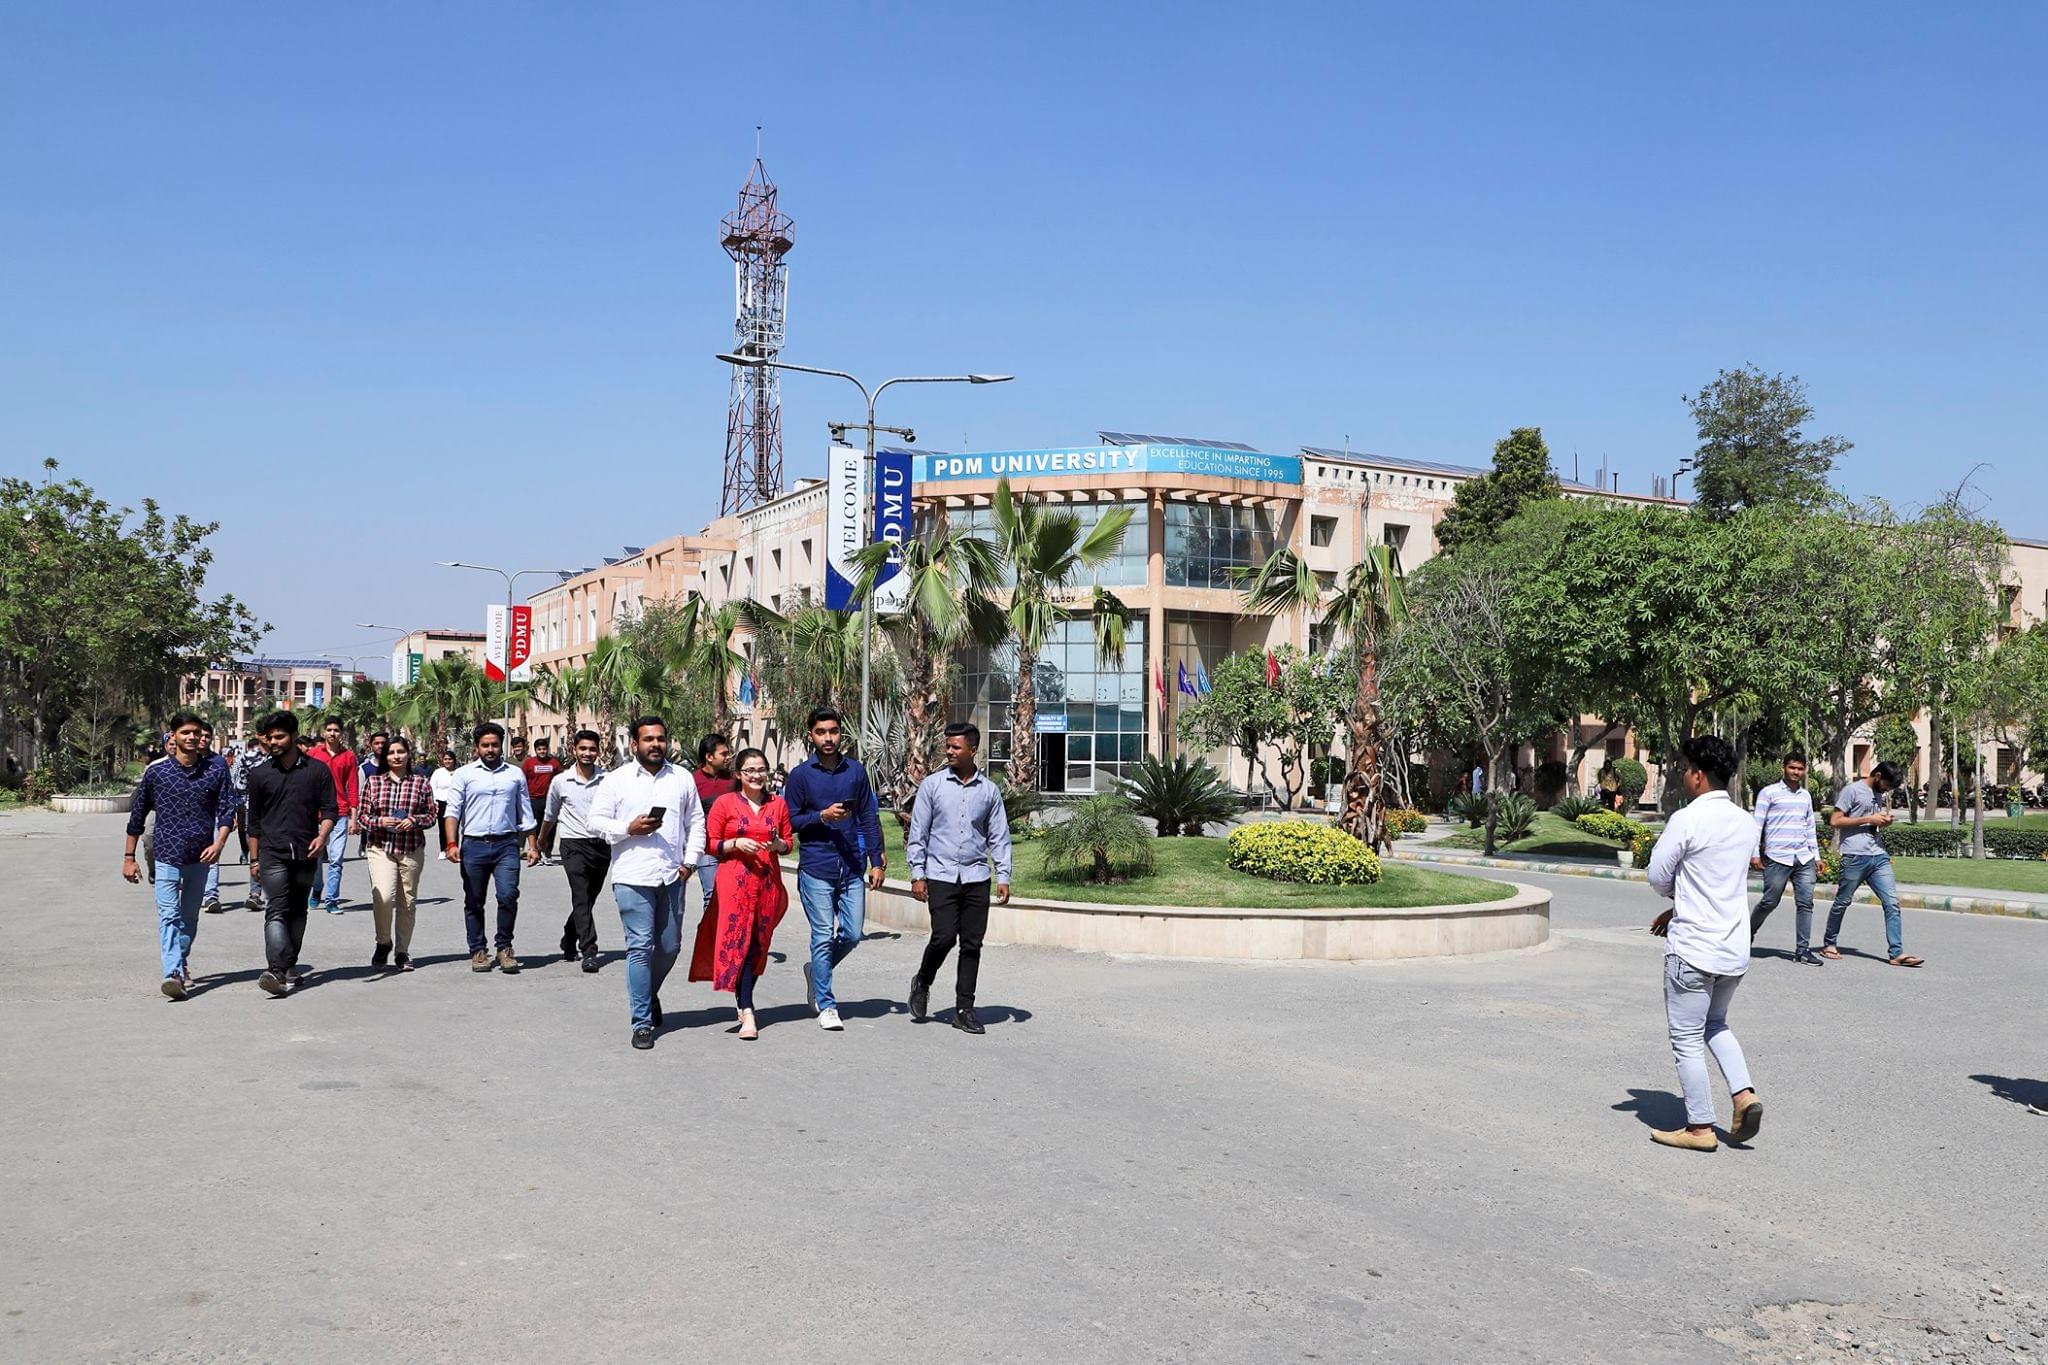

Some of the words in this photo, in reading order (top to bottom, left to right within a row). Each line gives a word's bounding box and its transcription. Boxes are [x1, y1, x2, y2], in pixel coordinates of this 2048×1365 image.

[934, 457, 983, 476] PDM
[991, 450, 1139, 474] UNIVERSITY
[1150, 448, 1209, 461] EXCELLENCE
[1213, 452, 1221, 461] IN
[1225, 454, 1271, 467] IMPARTING
[1178, 460, 1231, 473] EDUCATION
[1234, 466, 1260, 477] SINCE
[1263, 469, 1284, 481] 1995
[494, 609, 503, 659] WELCOME
[515, 612, 528, 660] PDMU
[412, 657, 421, 683] DMU
